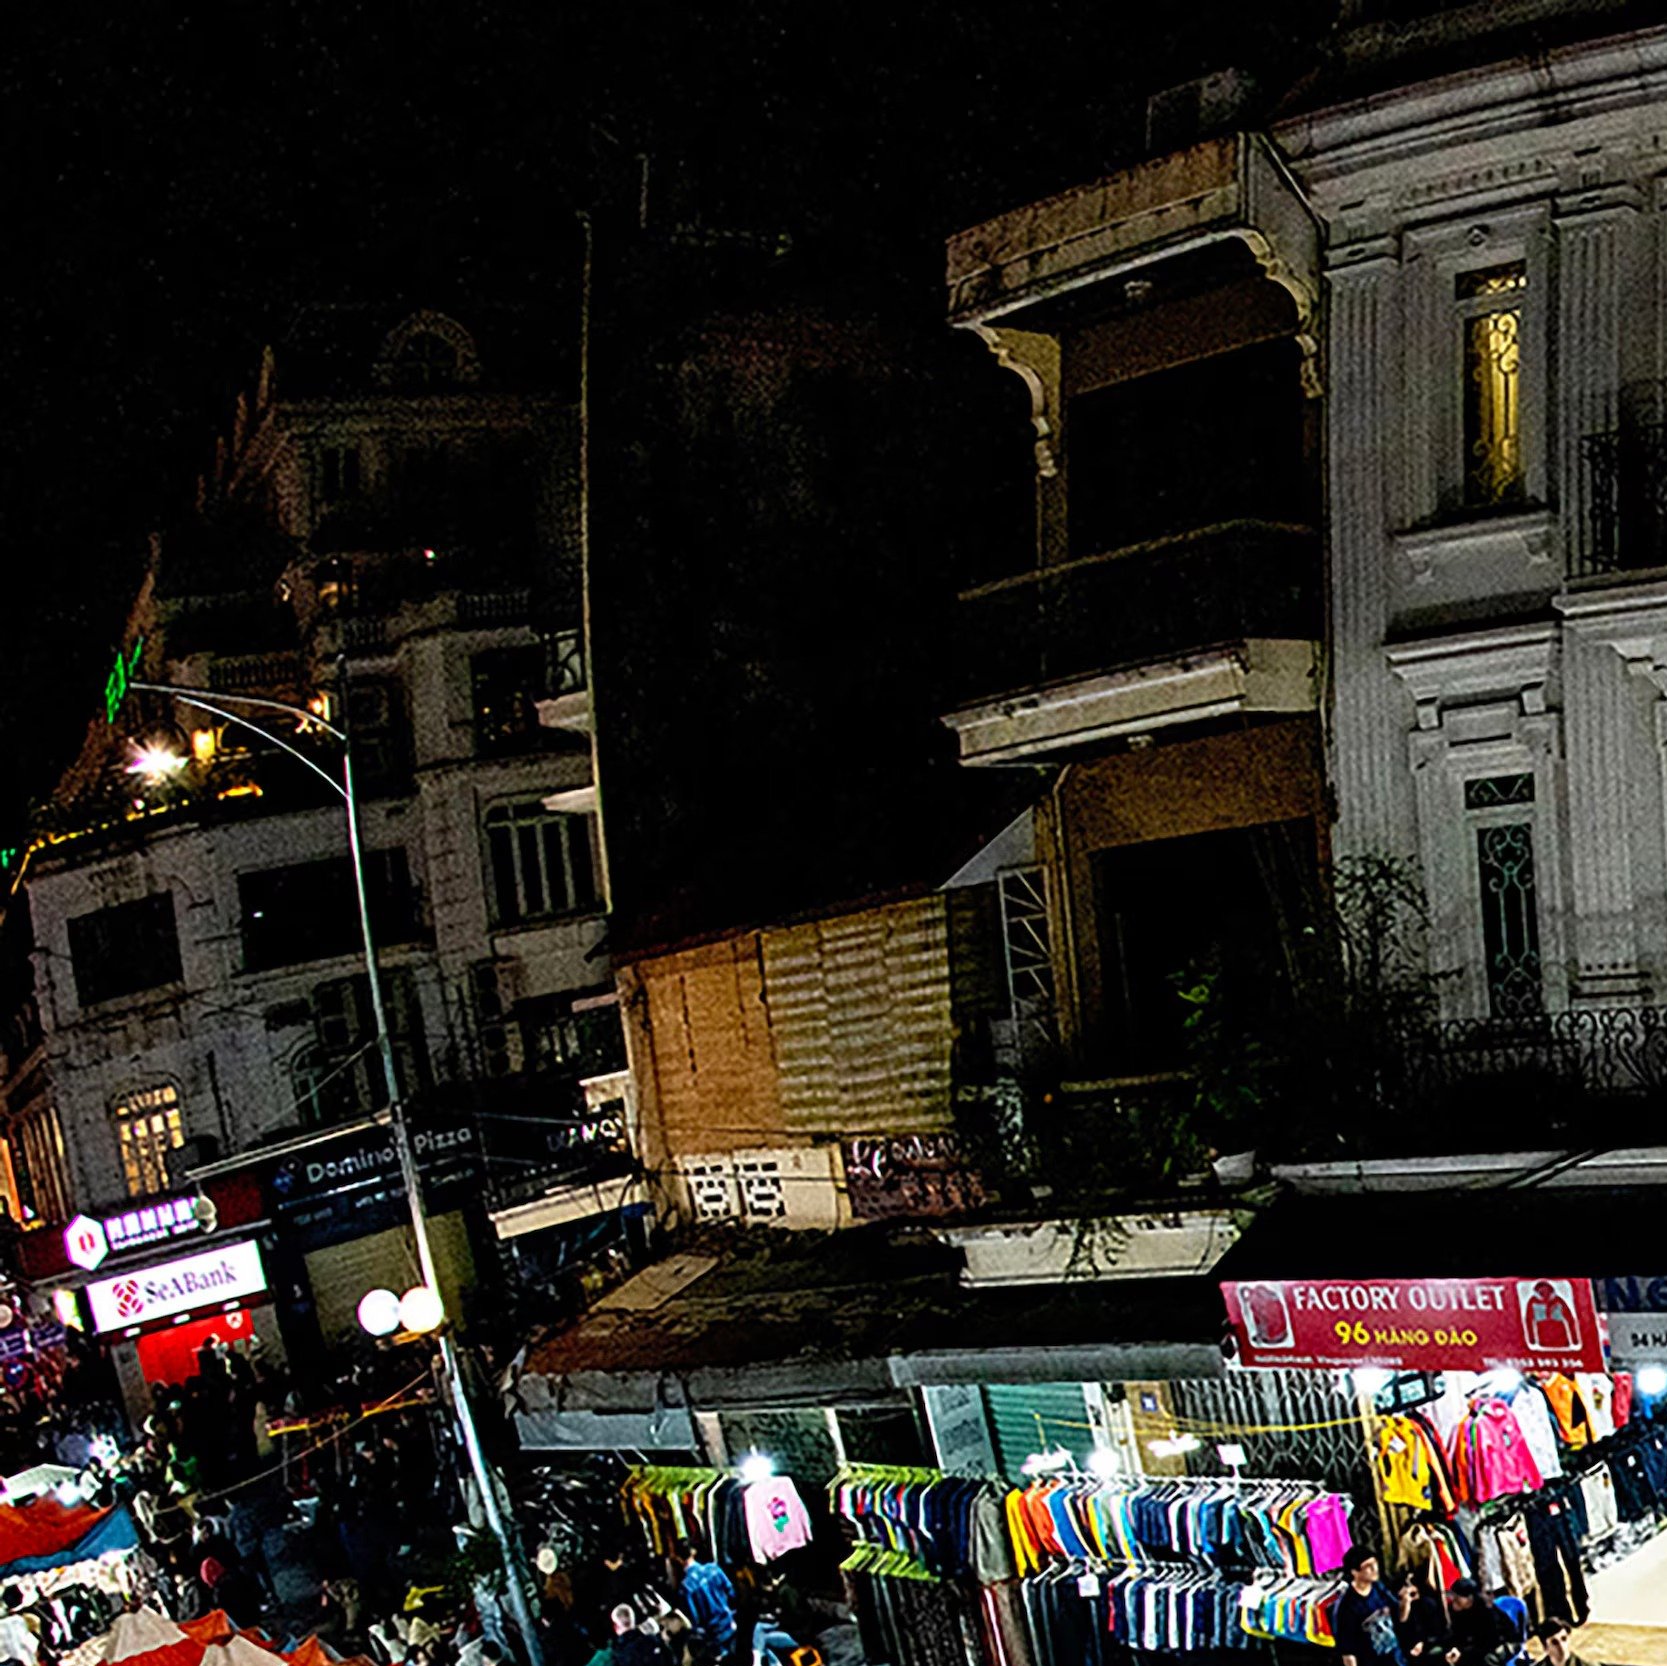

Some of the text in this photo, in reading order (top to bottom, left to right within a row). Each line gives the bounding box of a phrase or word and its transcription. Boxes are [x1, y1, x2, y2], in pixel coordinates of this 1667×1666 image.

[414, 1125, 472, 1155] Pizza
[143, 1260, 238, 1304] SeABank
[1295, 1285, 1505, 1312] FACTORY OUTLET
[1334, 1321, 1370, 1346] 96
